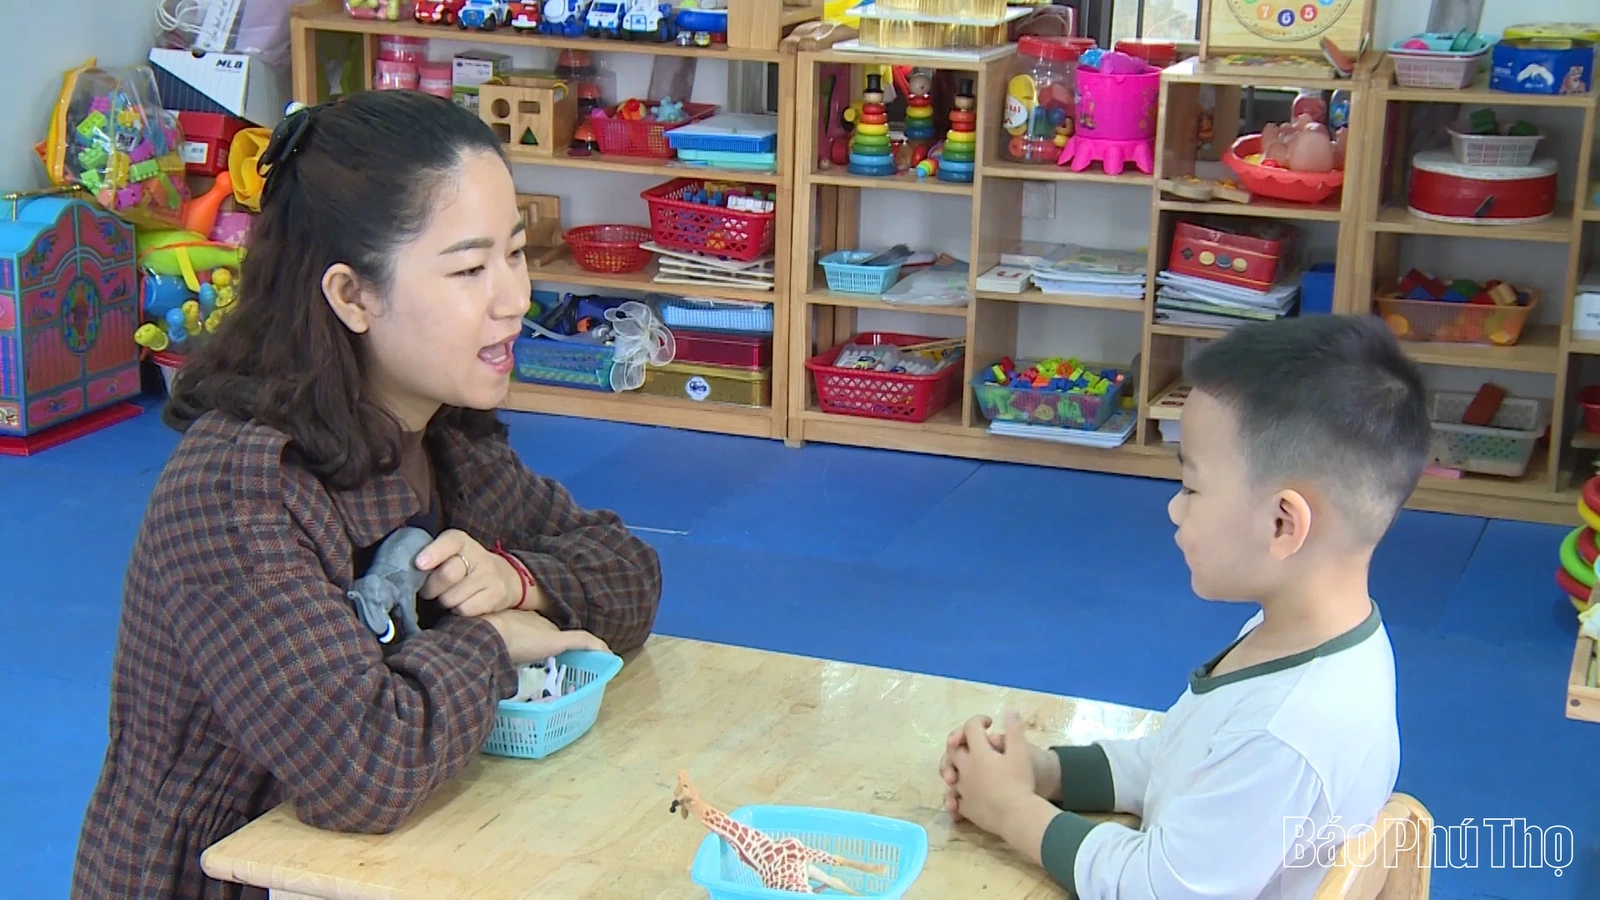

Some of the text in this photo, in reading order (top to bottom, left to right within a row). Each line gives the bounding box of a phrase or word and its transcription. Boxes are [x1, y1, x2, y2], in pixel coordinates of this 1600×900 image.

[1282, 12, 1292, 24] 6
[1304, 8, 1314, 19] 5
[216, 59, 243, 69] MLB
